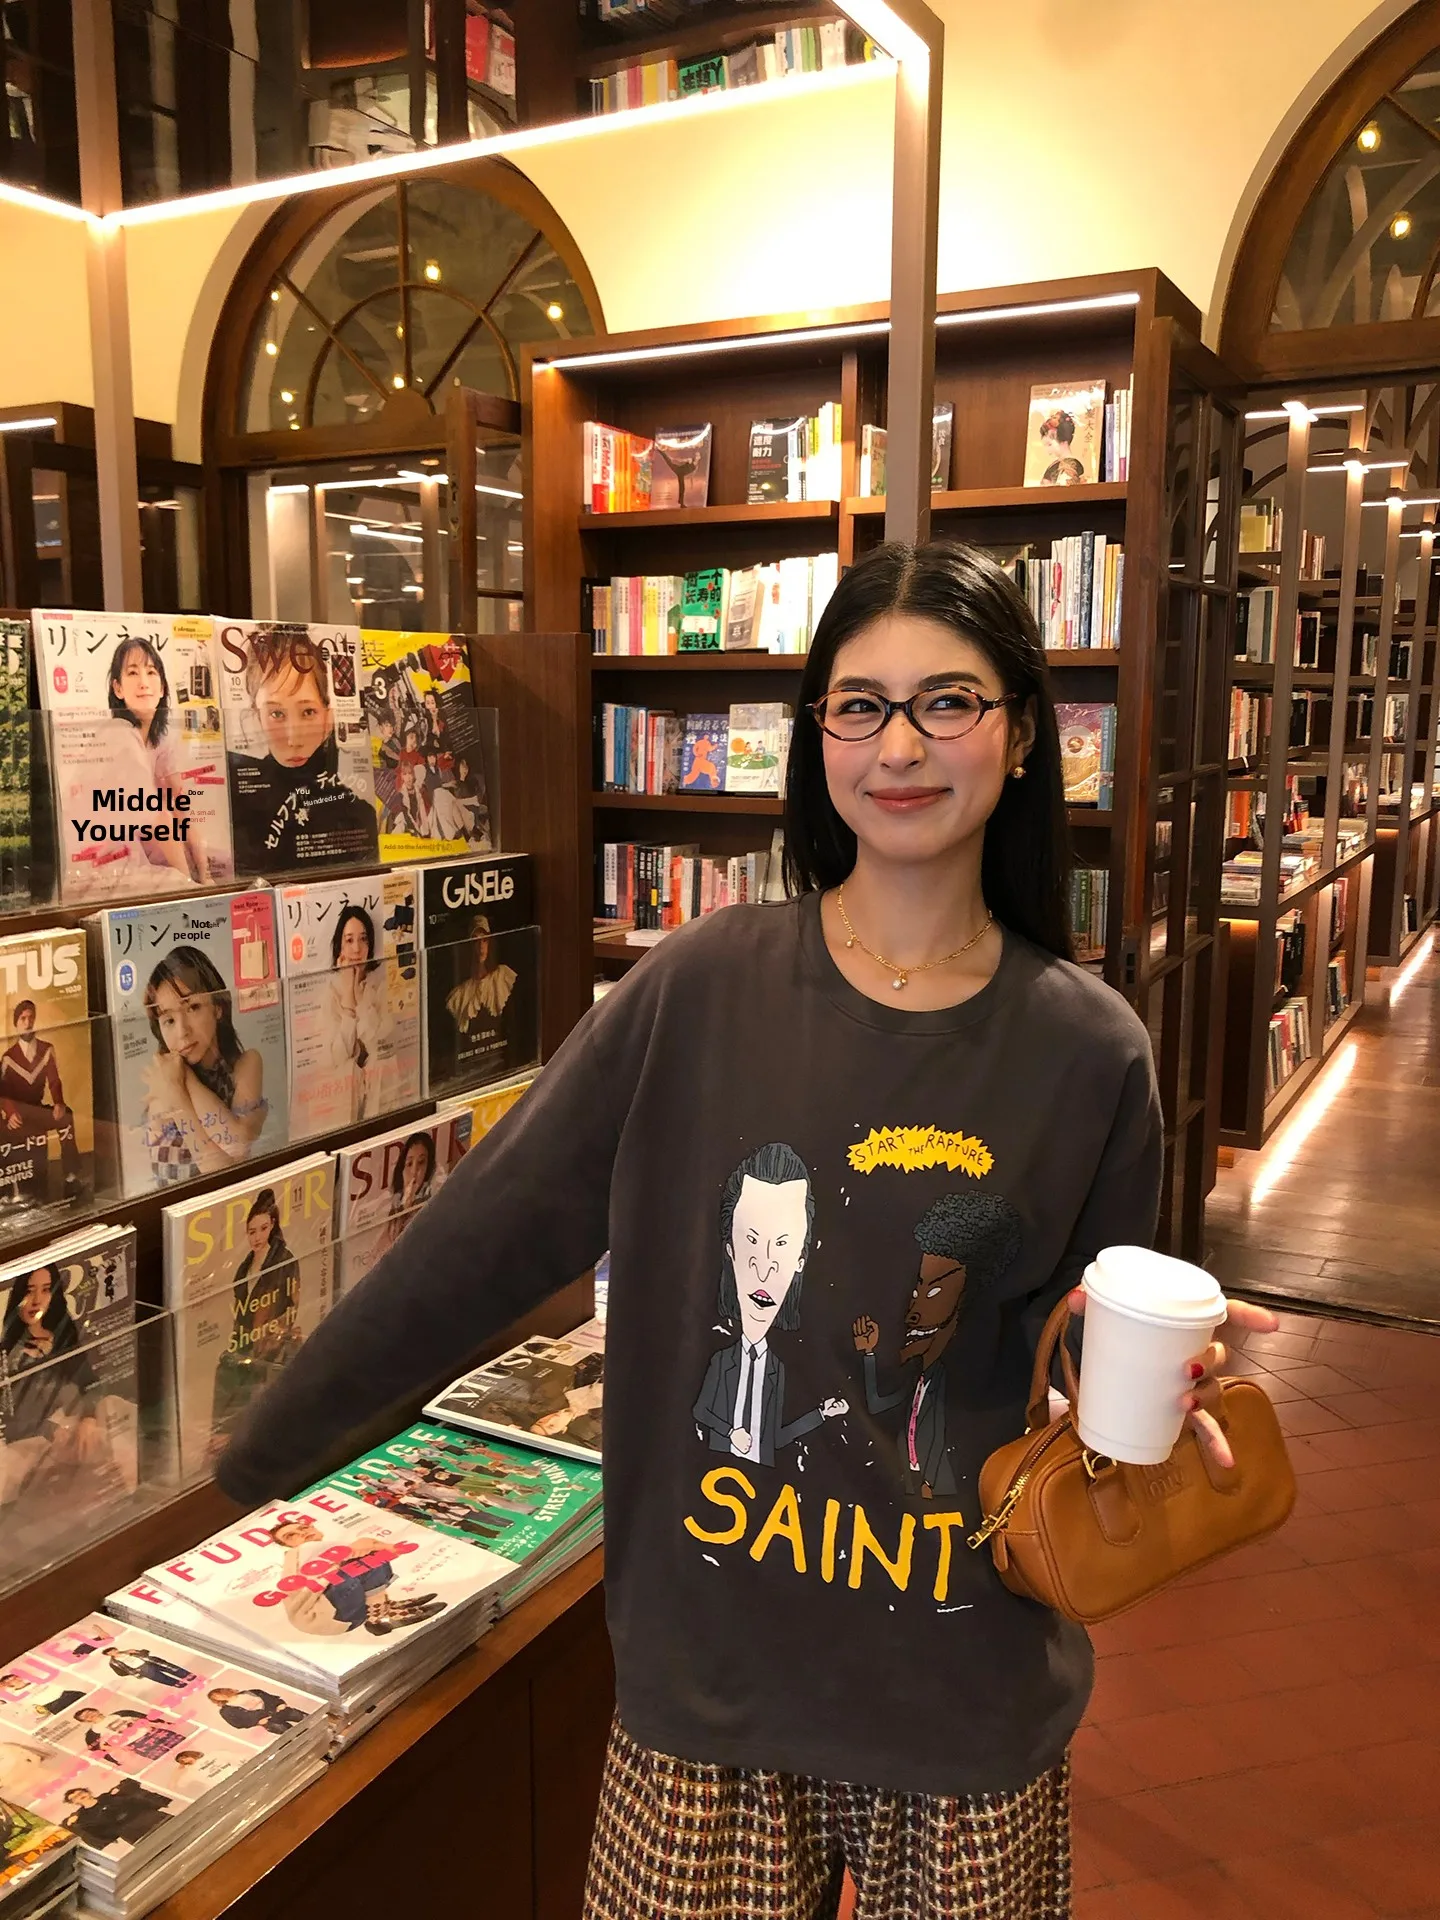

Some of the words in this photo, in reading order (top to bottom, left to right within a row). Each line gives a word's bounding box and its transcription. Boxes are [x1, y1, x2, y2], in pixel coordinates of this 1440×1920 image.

[681, 632, 720, 650] 年轻人
[231, 676, 241, 686] 10
[374, 677, 387, 700] 3
[287, 892, 380, 929] リンネル
[6, 1159, 34, 1175] STYLE
[854, 1133, 907, 1163] START
[908, 1144, 925, 1156] THE
[925, 1133, 984, 1167] RAPTURE
[294, 1186, 303, 1202] 11
[229, 1288, 280, 1318] Wear
[328, 1428, 447, 1491] UDGE
[533, 1486, 572, 1522] STREET
[166, 1494, 348, 1583] FUDGE
[683, 1466, 964, 1602] SAINT
[252, 1545, 353, 1608] GOOD
[305, 1540, 420, 1593] ITEMS
